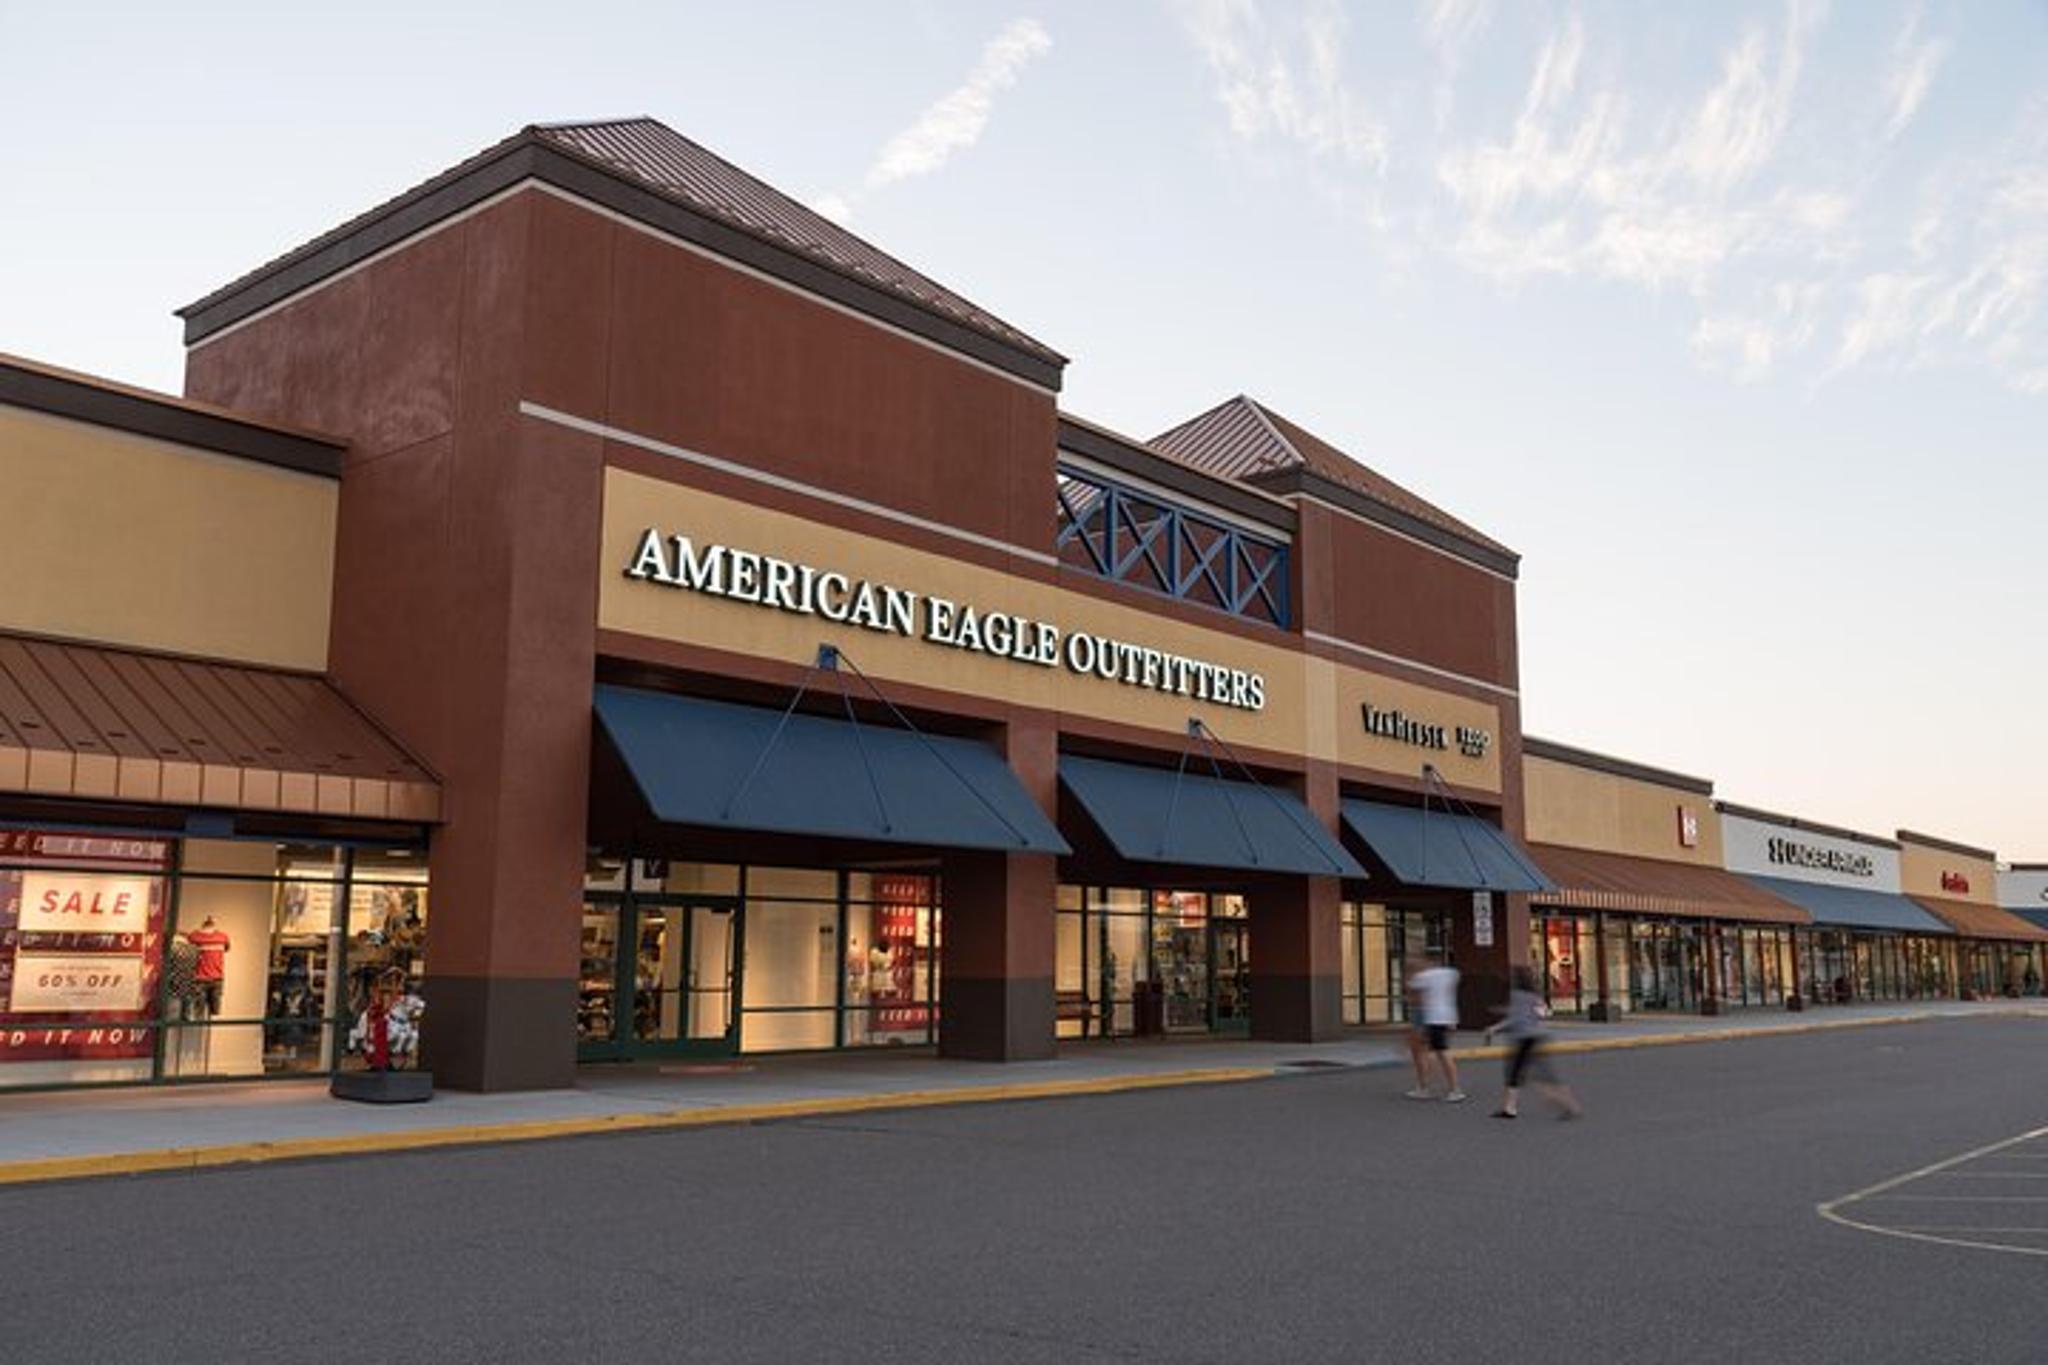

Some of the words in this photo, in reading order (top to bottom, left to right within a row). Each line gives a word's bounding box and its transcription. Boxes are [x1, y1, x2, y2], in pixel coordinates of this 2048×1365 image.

[627, 528, 917, 637] AMERICAN
[927, 598, 1059, 668] EAGLE
[1067, 633, 1266, 711] OUTFITTERS
[40, 889, 131, 915] SALE
[38, 974, 77, 988] 60%
[87, 974, 123, 988] OFF
[44, 1029, 73, 1045] IT
[87, 1028, 148, 1046] NOW
